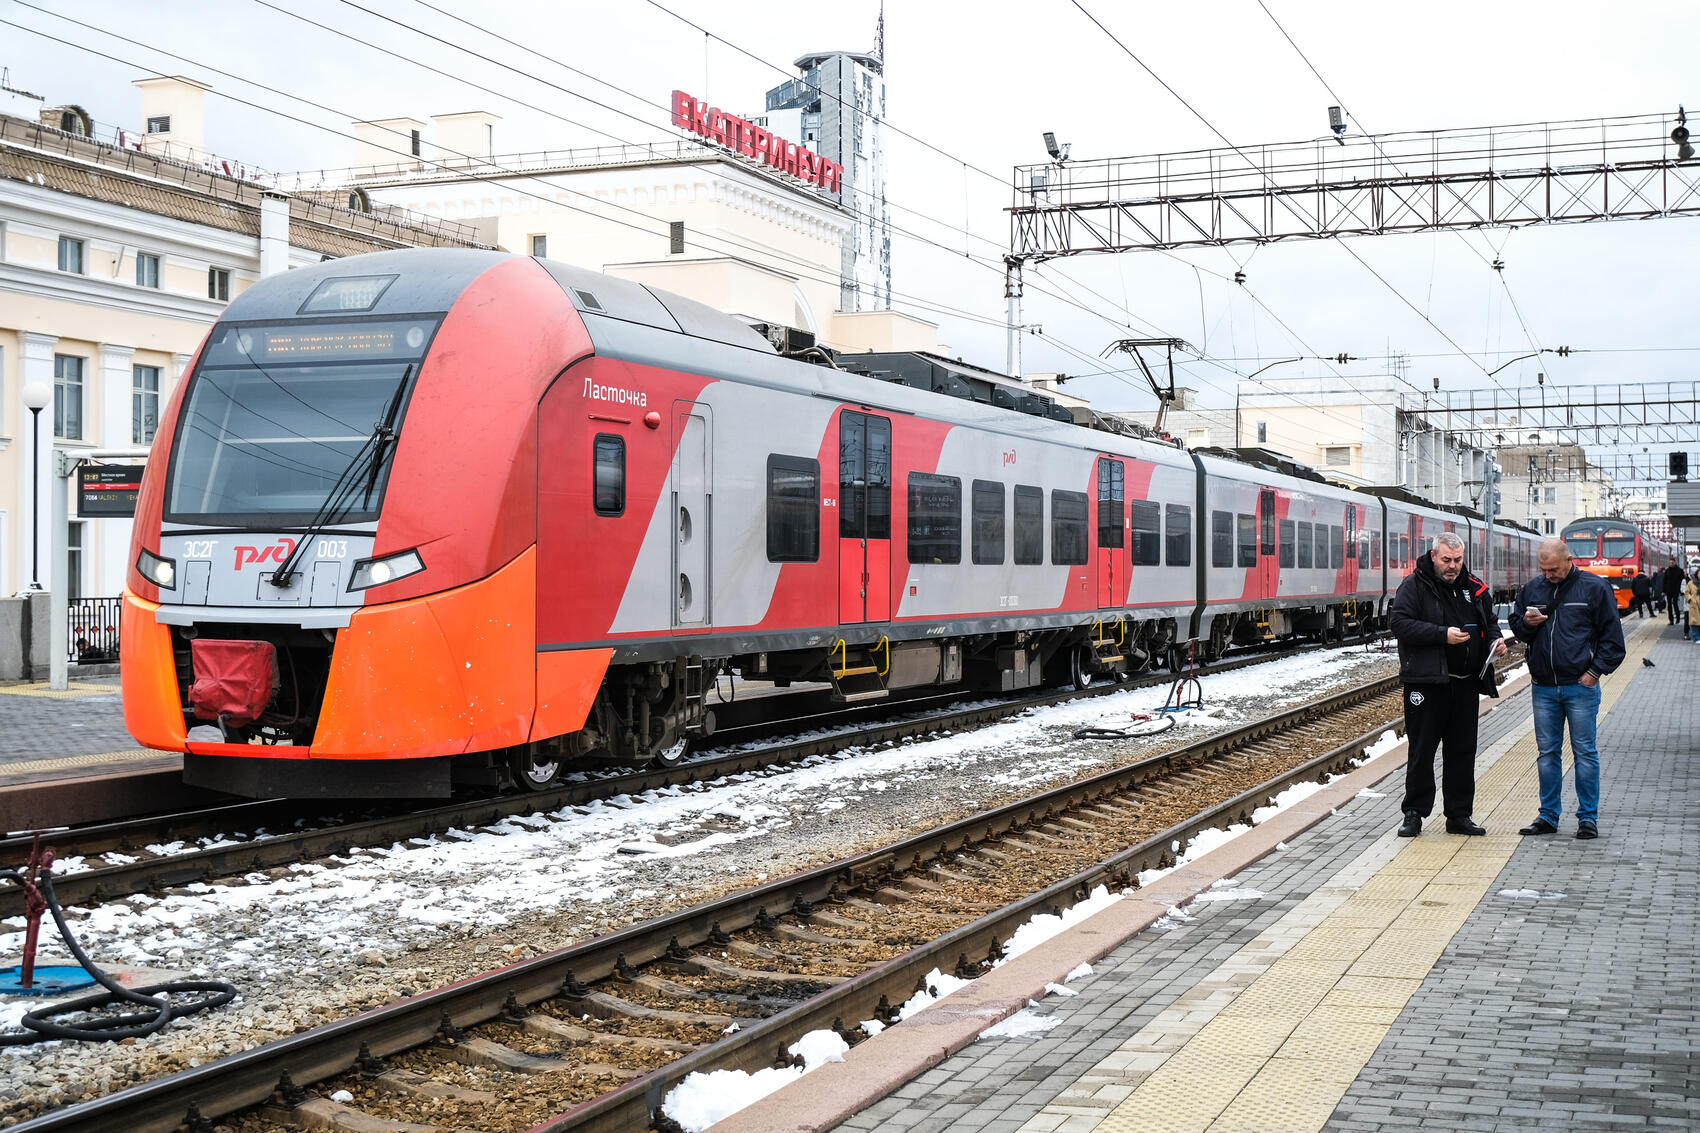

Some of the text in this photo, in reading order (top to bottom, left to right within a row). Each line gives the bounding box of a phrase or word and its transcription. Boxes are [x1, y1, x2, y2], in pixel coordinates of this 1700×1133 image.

[672, 90, 845, 193] ЕКАТЕРИНБУРГ
[583, 377, 647, 407] Ласточка
[317, 541, 348, 558] 003
